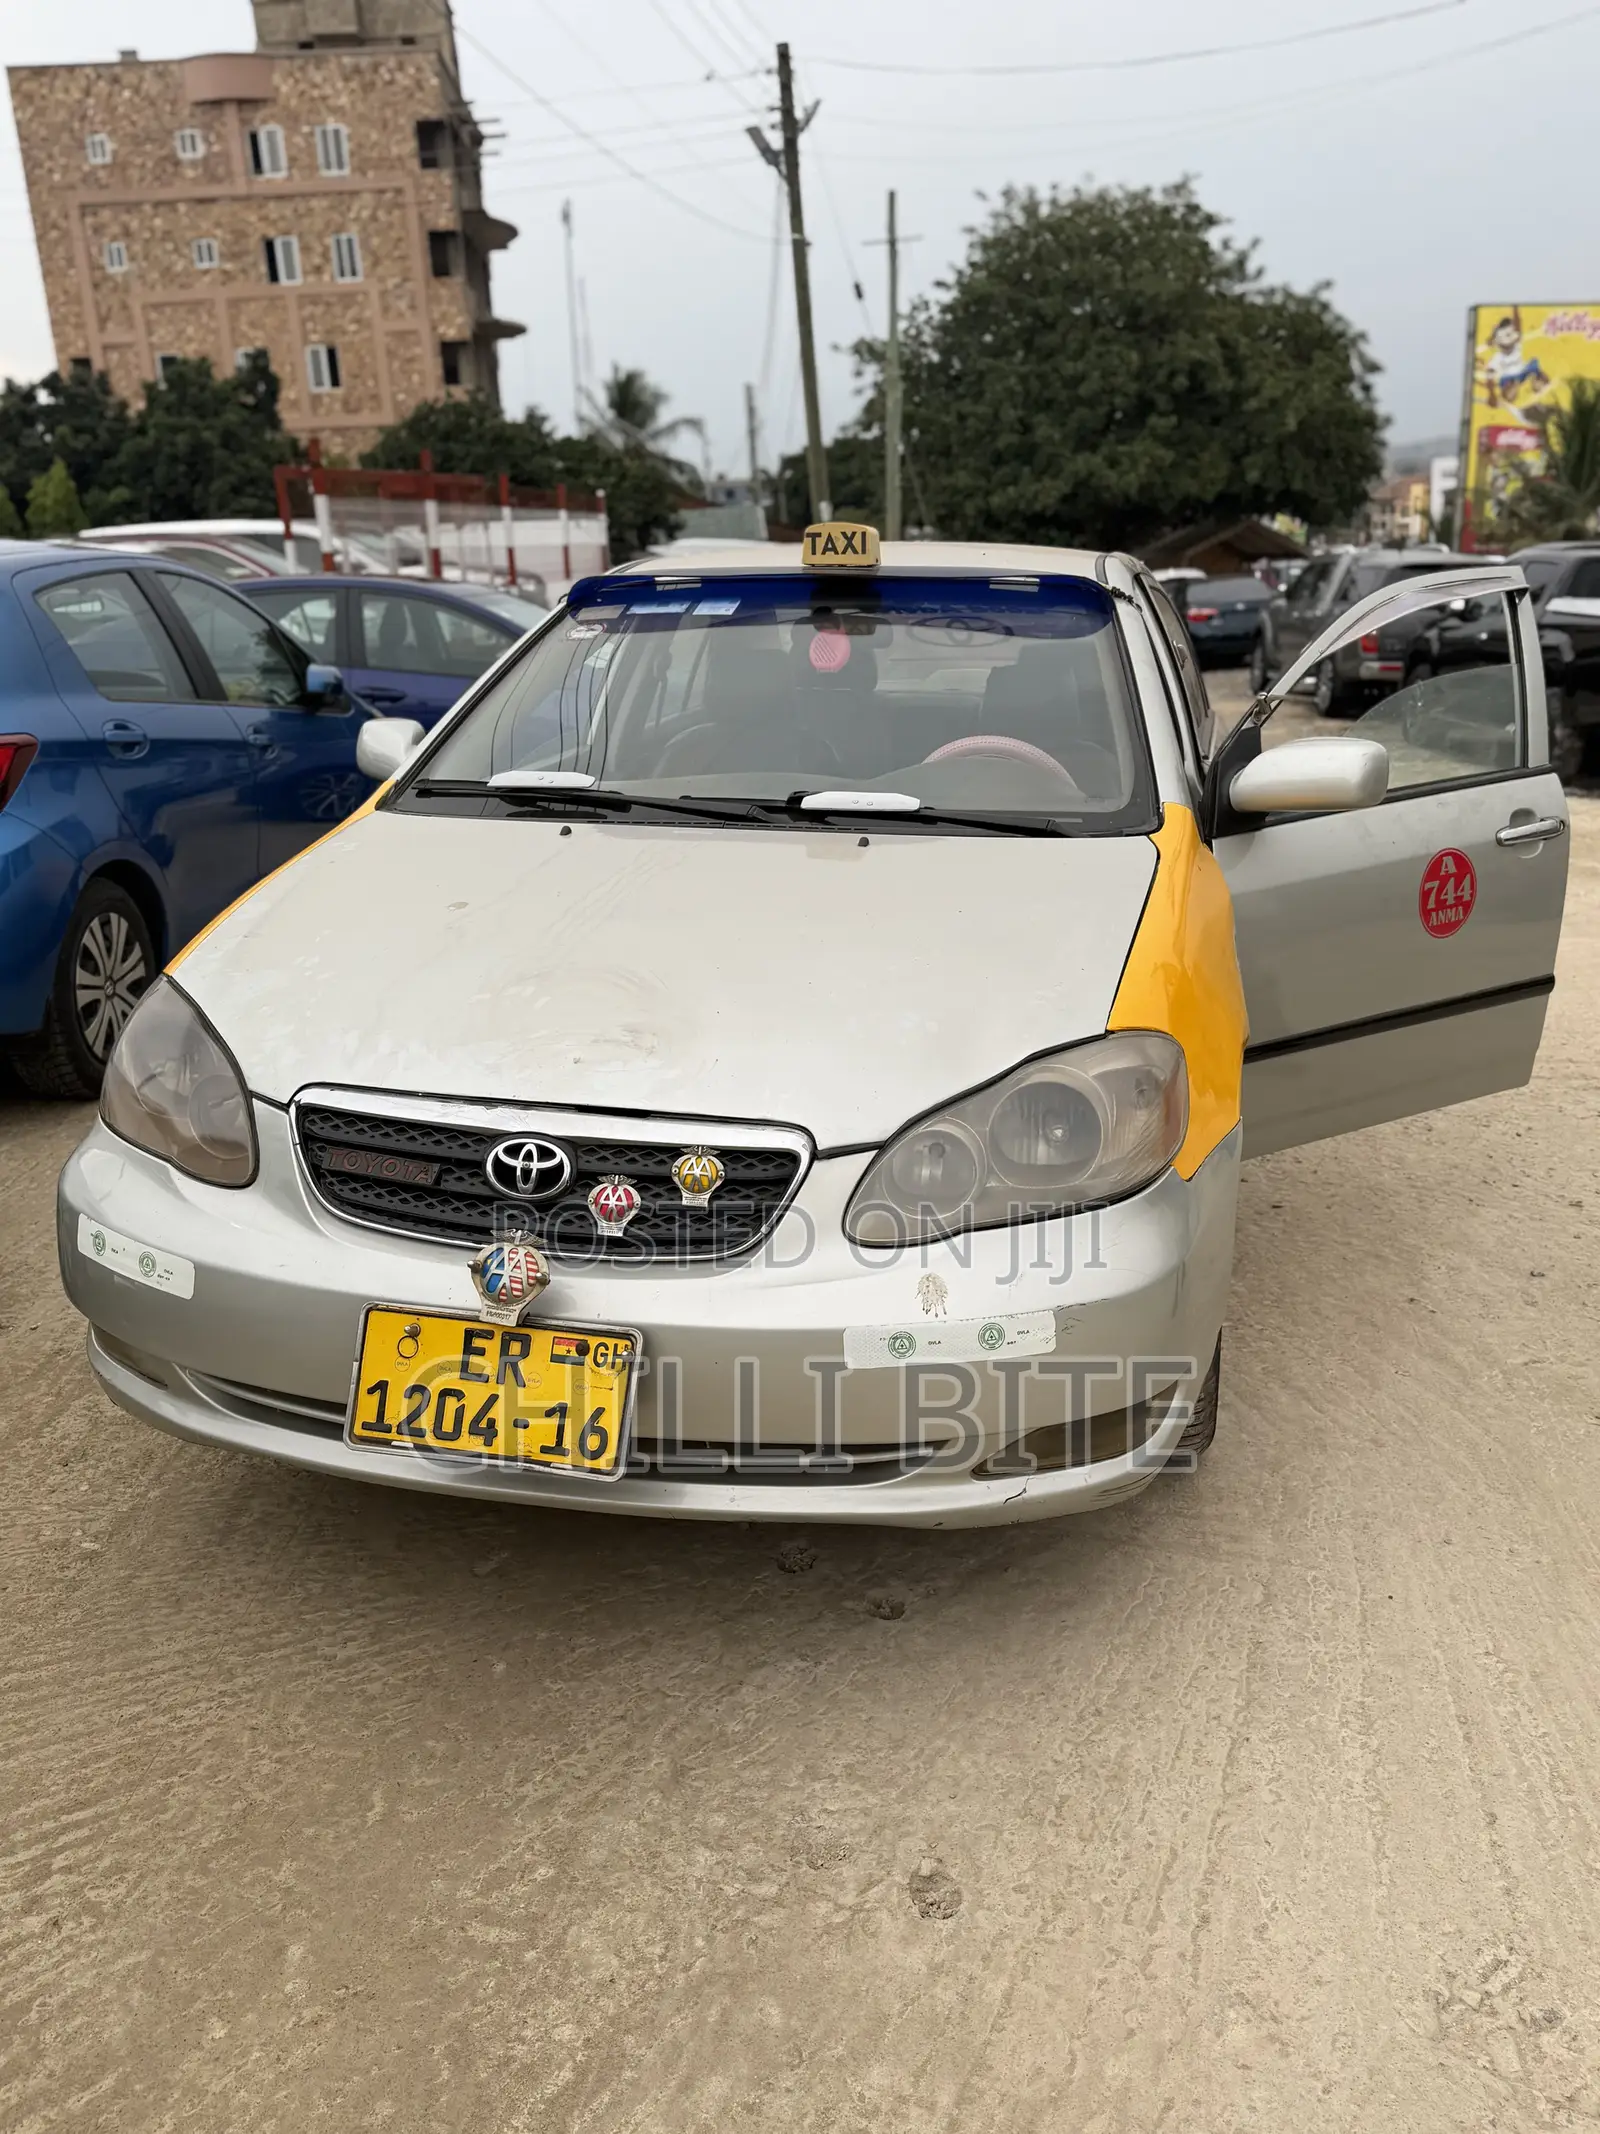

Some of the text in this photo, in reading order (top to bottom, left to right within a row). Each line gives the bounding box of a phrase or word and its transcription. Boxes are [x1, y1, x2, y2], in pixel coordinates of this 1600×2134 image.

[806, 531, 867, 556] TAXI
[1440, 855, 1457, 875] A
[1424, 873, 1472, 909] 744
[1429, 905, 1464, 927] ANMA
[328, 1149, 433, 1183] TOYOTA
[460, 1327, 532, 1388] ER
[593, 1341, 628, 1371] GH
[361, 1379, 609, 1460] 1204-16
